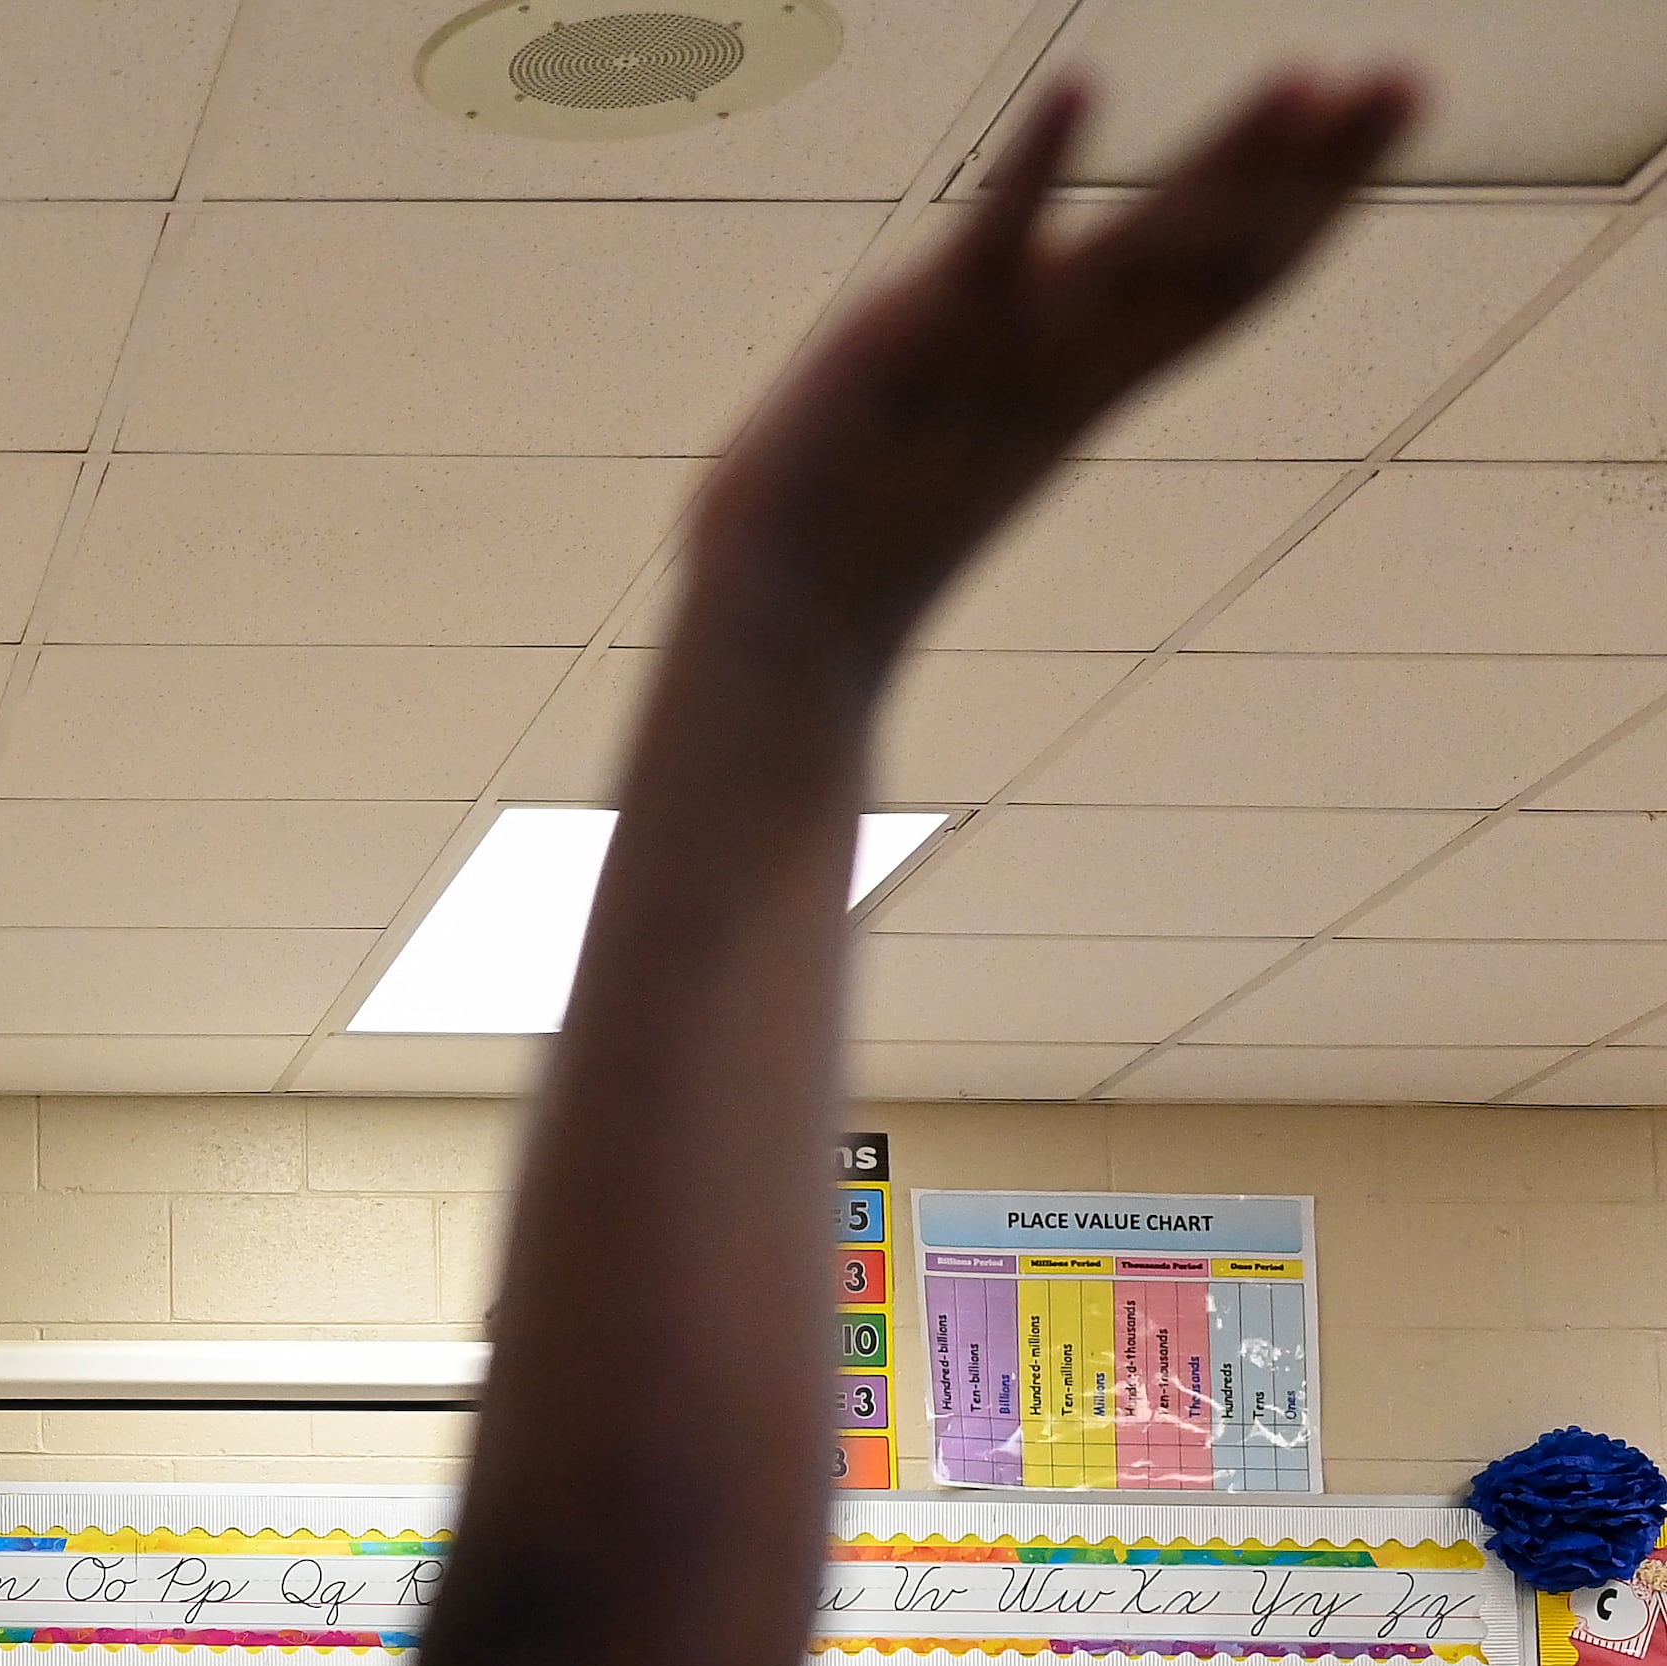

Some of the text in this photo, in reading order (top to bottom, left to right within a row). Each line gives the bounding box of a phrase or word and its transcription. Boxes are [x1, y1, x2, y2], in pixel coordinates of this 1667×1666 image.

[1007, 1212, 1214, 1232] PLACE VALUE CHART
[844, 1260, 868, 1293] 3
[1254, 1263, 1284, 1271] Period
[842, 1323, 879, 1357] 10
[937, 1314, 952, 1410] Hundred-billions
[968, 1343, 982, 1413] Ten-billions
[1028, 1315, 1042, 1416] Hundred-millions
[1061, 1343, 1073, 1416] Ten-millions
[999, 1374, 1011, 1415] Billions
[1094, 1373, 1106, 1416] Millions
[1221, 1363, 1234, 1419] Hundreds
[1252, 1391, 1265, 1419] Tens
[1285, 1390, 1297, 1420] Ones
[66, 1557, 137, 1601] Oo
[157, 1557, 249, 1624] Pp
[281, 1559, 367, 1626] Qq
[894, 1566, 969, 1611] Vv
[998, 1567, 1116, 1613] Ww
[1121, 1569, 1220, 1615] Xx
[1250, 1570, 1362, 1637] Yy
[1377, 1572, 1476, 1639] Zz
[1596, 1588, 1618, 1621] C
